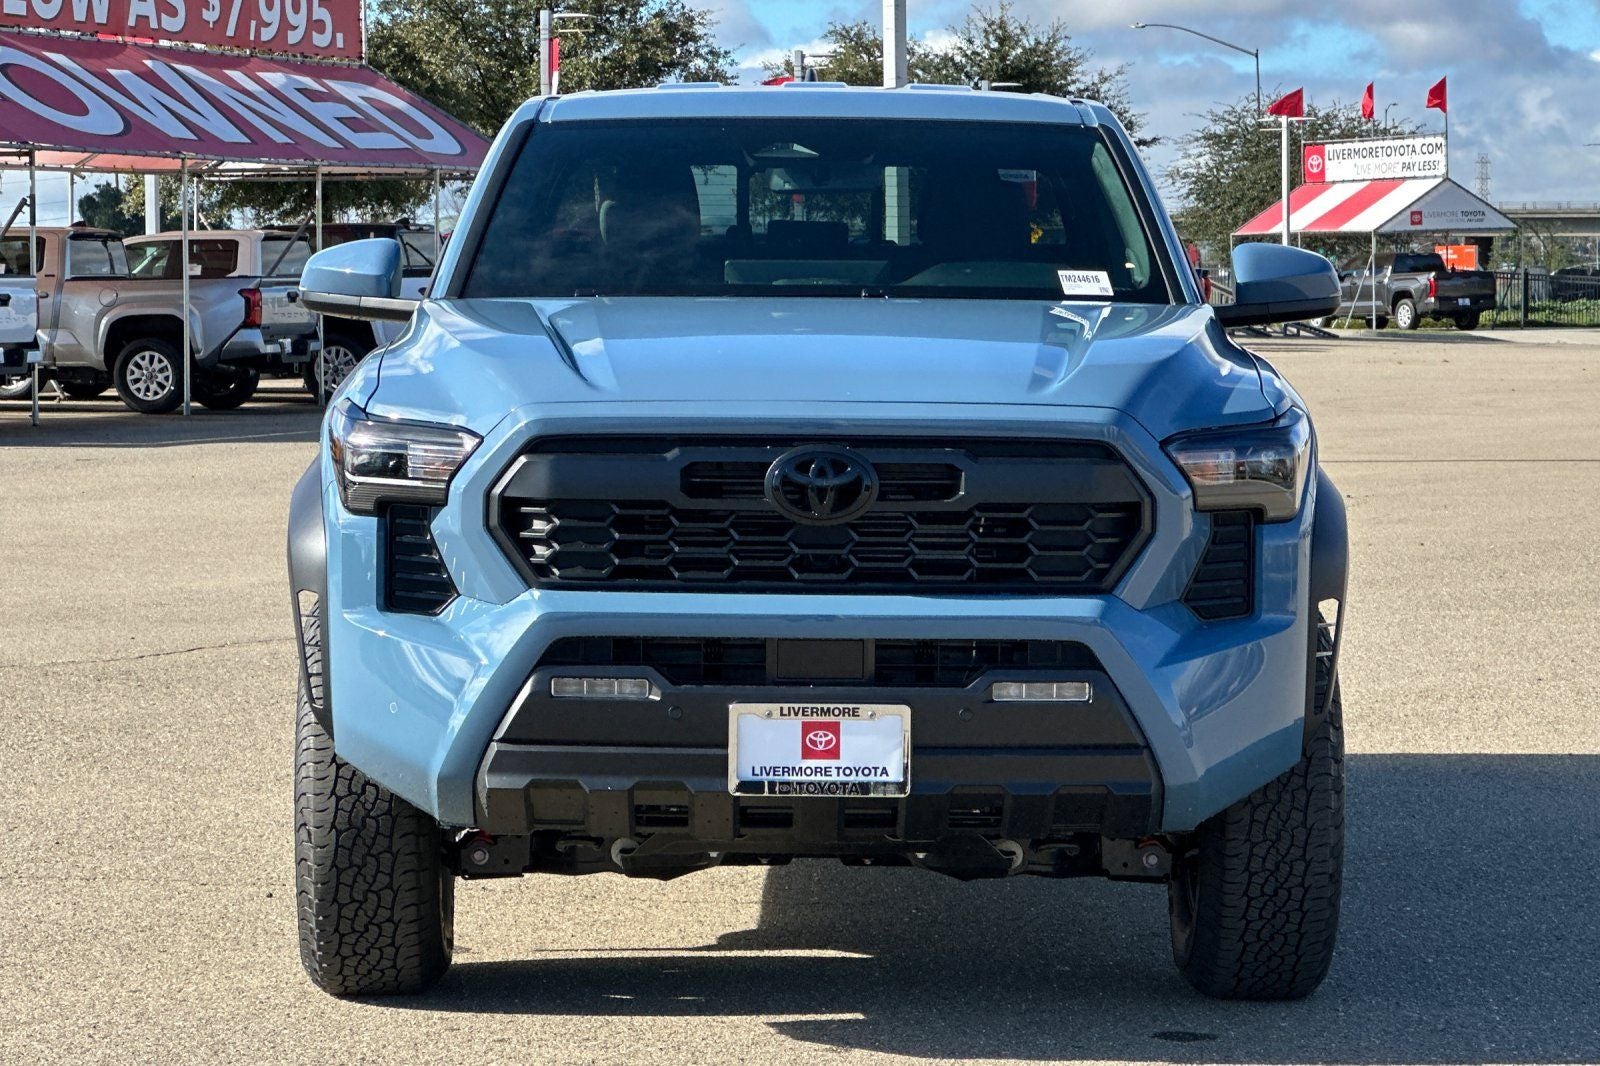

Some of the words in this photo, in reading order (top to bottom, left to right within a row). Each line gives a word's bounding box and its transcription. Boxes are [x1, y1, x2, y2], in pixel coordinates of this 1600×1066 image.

[1327, 142, 1443, 161] LIVERMORETOYOTA.COM
[1401, 160, 1417, 172] PAY
[1418, 159, 1440, 171] LESS!
[779, 706, 860, 718] LIVERMORE
[751, 766, 833, 778] LIVERMORE
[837, 766, 889, 778] TOYOTA
[799, 782, 859, 795] TOYOTA
